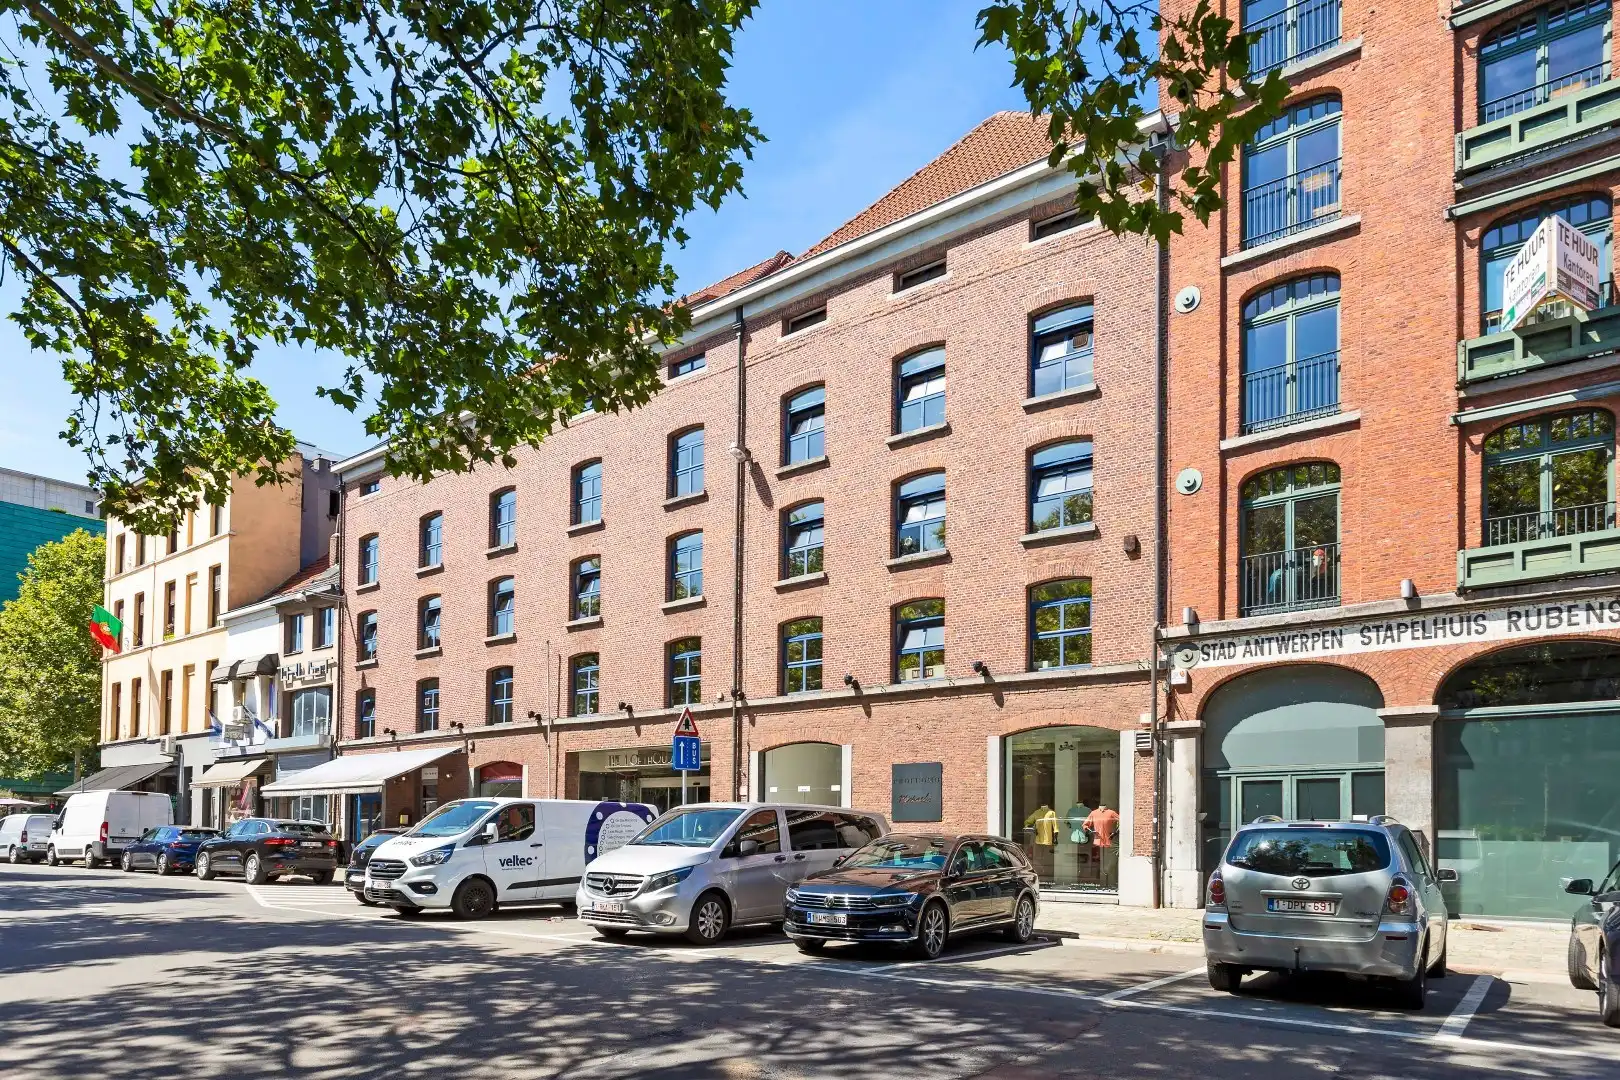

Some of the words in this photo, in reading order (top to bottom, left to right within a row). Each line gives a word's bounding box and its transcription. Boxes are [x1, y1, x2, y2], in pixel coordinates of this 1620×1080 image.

[1505, 264, 1515, 289] TE
[1517, 227, 1545, 274] HUUR
[1558, 222, 1570, 248] TE
[1571, 232, 1598, 267] HUUR
[1563, 251, 1594, 287] Kantoren
[1201, 641, 1237, 662] STAD
[1242, 628, 1344, 659] ANTWERPEN
[1359, 612, 1488, 647] STAPELHUIS
[1506, 599, 1620, 633] RUBENS
[499, 854, 533, 868] veltec
